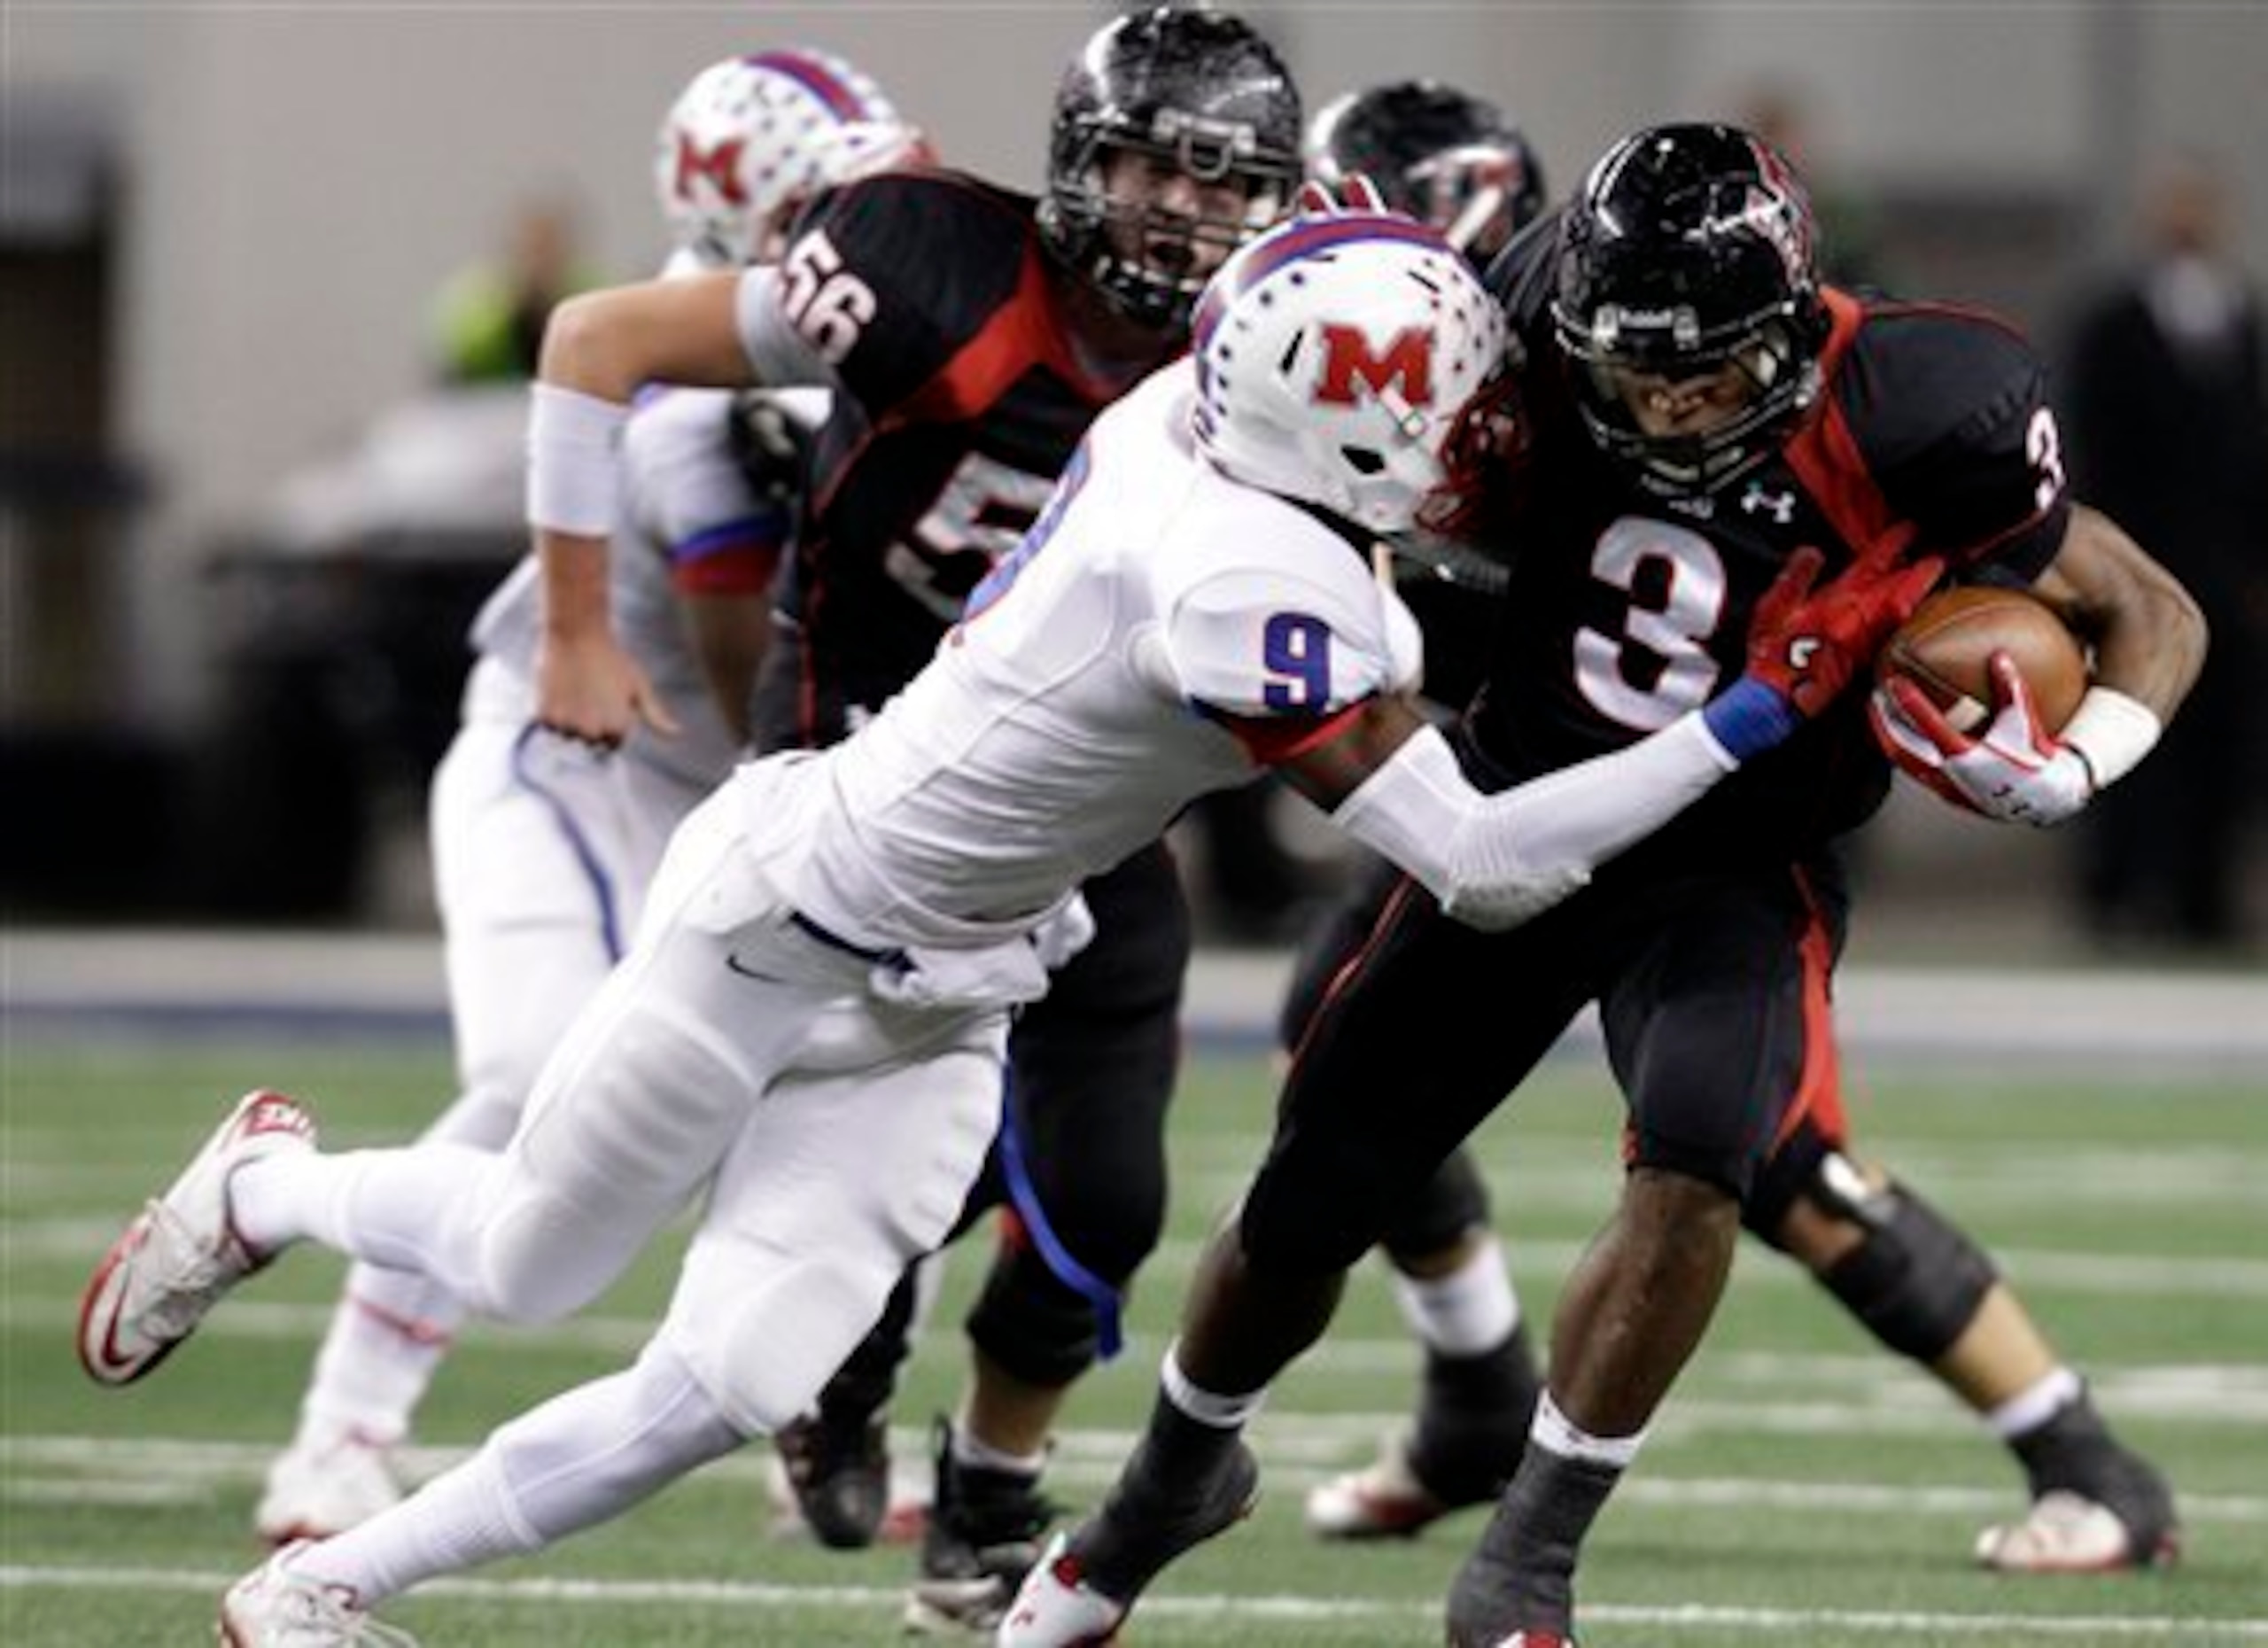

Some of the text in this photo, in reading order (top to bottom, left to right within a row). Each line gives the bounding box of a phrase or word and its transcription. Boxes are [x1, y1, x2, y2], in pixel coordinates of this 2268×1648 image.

[676, 131, 749, 206] M
[778, 227, 875, 365] 56
[1313, 323, 1436, 408] M
[1263, 611, 1330, 713] 9
[1573, 514, 1727, 732] 3
